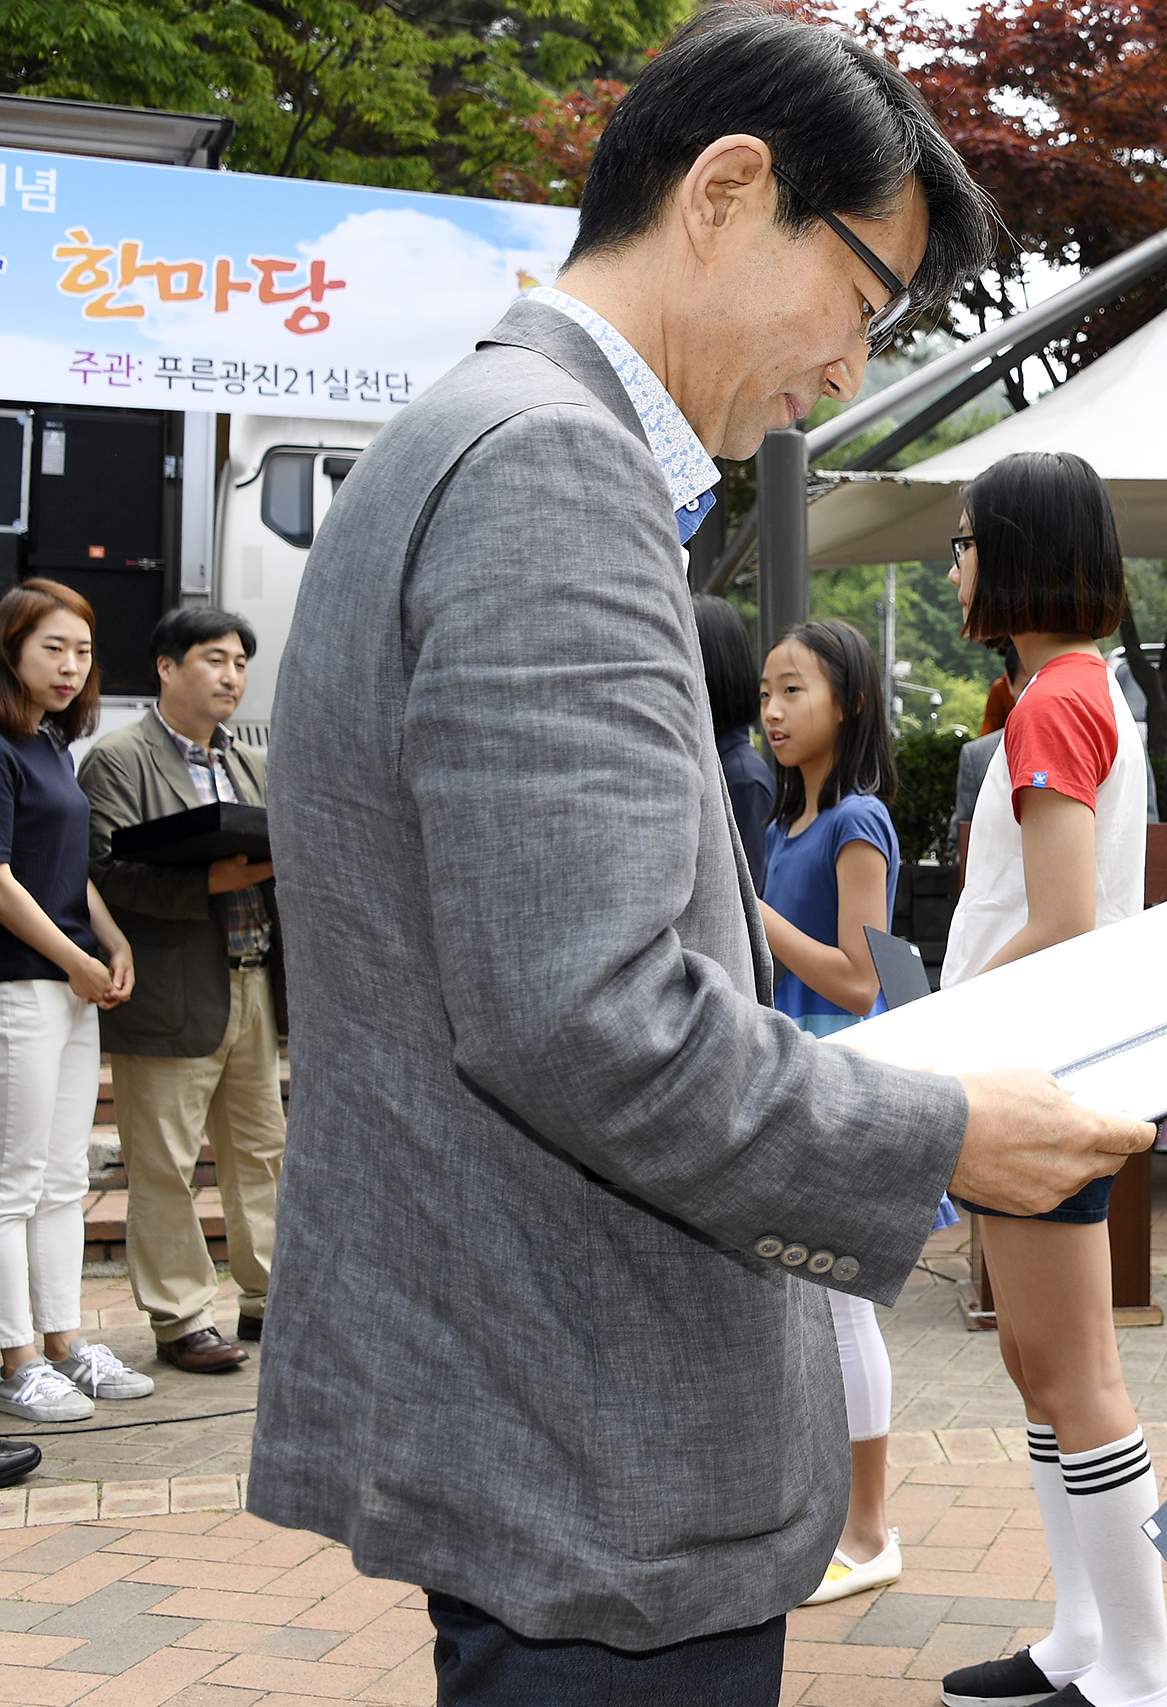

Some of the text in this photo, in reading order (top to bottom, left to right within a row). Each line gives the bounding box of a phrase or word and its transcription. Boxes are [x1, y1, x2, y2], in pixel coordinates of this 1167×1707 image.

[54, 228, 347, 335] 한마당
[69, 351, 414, 403] 주관: 푸른광진21실천단
